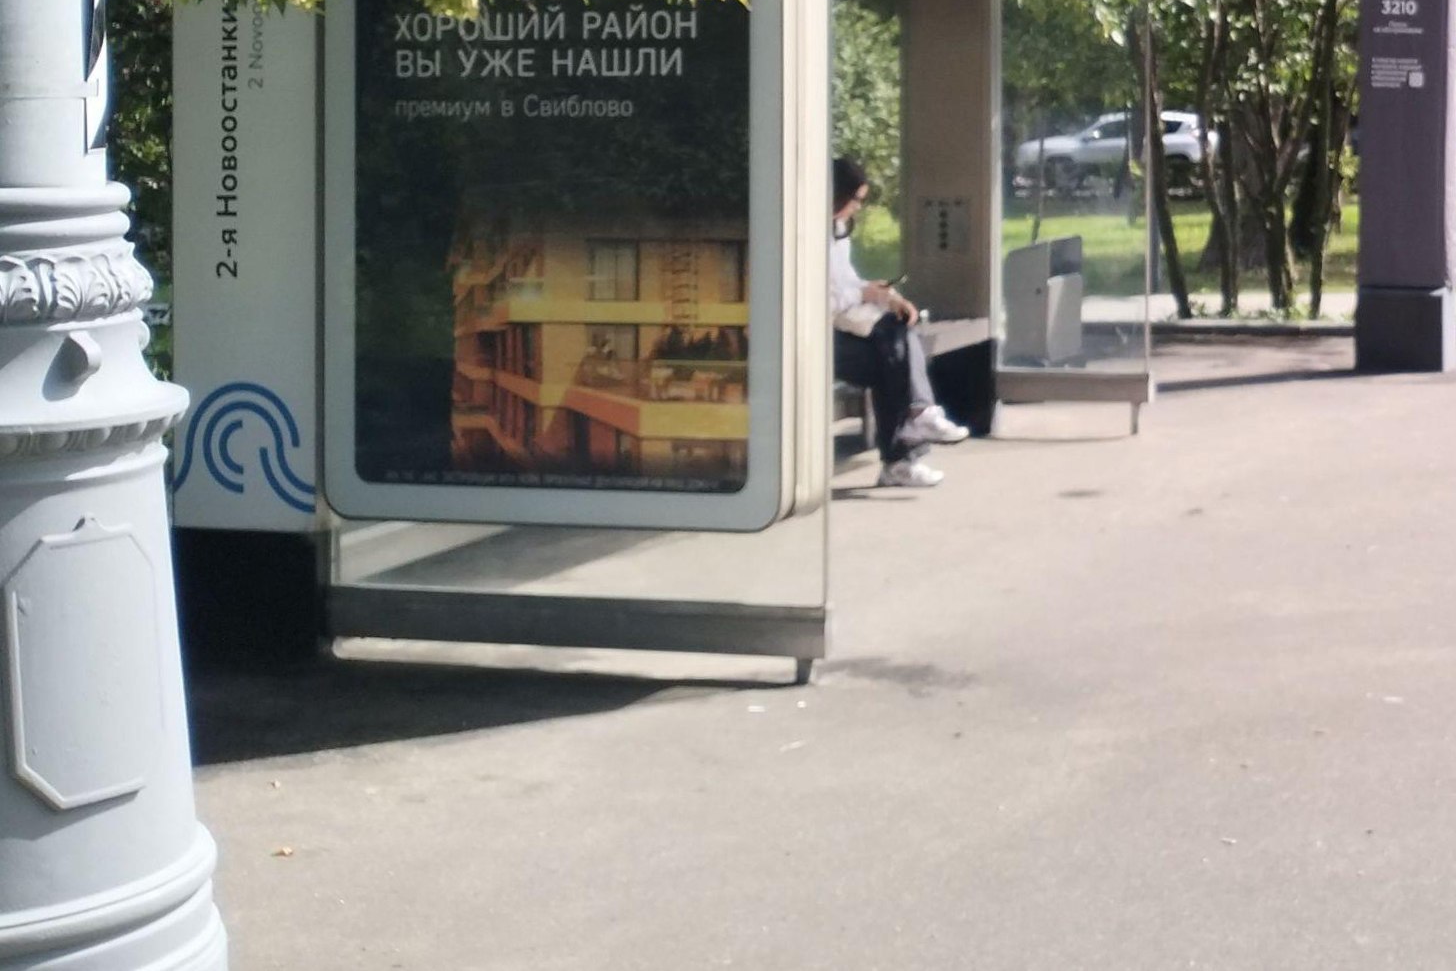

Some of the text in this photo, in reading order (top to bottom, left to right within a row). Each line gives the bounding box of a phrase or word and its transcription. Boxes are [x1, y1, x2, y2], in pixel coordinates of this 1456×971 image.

[394, 3, 698, 42] ХОРОШИЙ РАЙОН
[1381, 0, 1417, 15] 3210
[395, 47, 684, 78] ВЫ УЖЕ НАШЛИ
[247, 77, 264, 88] 2
[395, 93, 634, 122] премиум в Свиблово
[215, 228, 238, 278] 2-я
